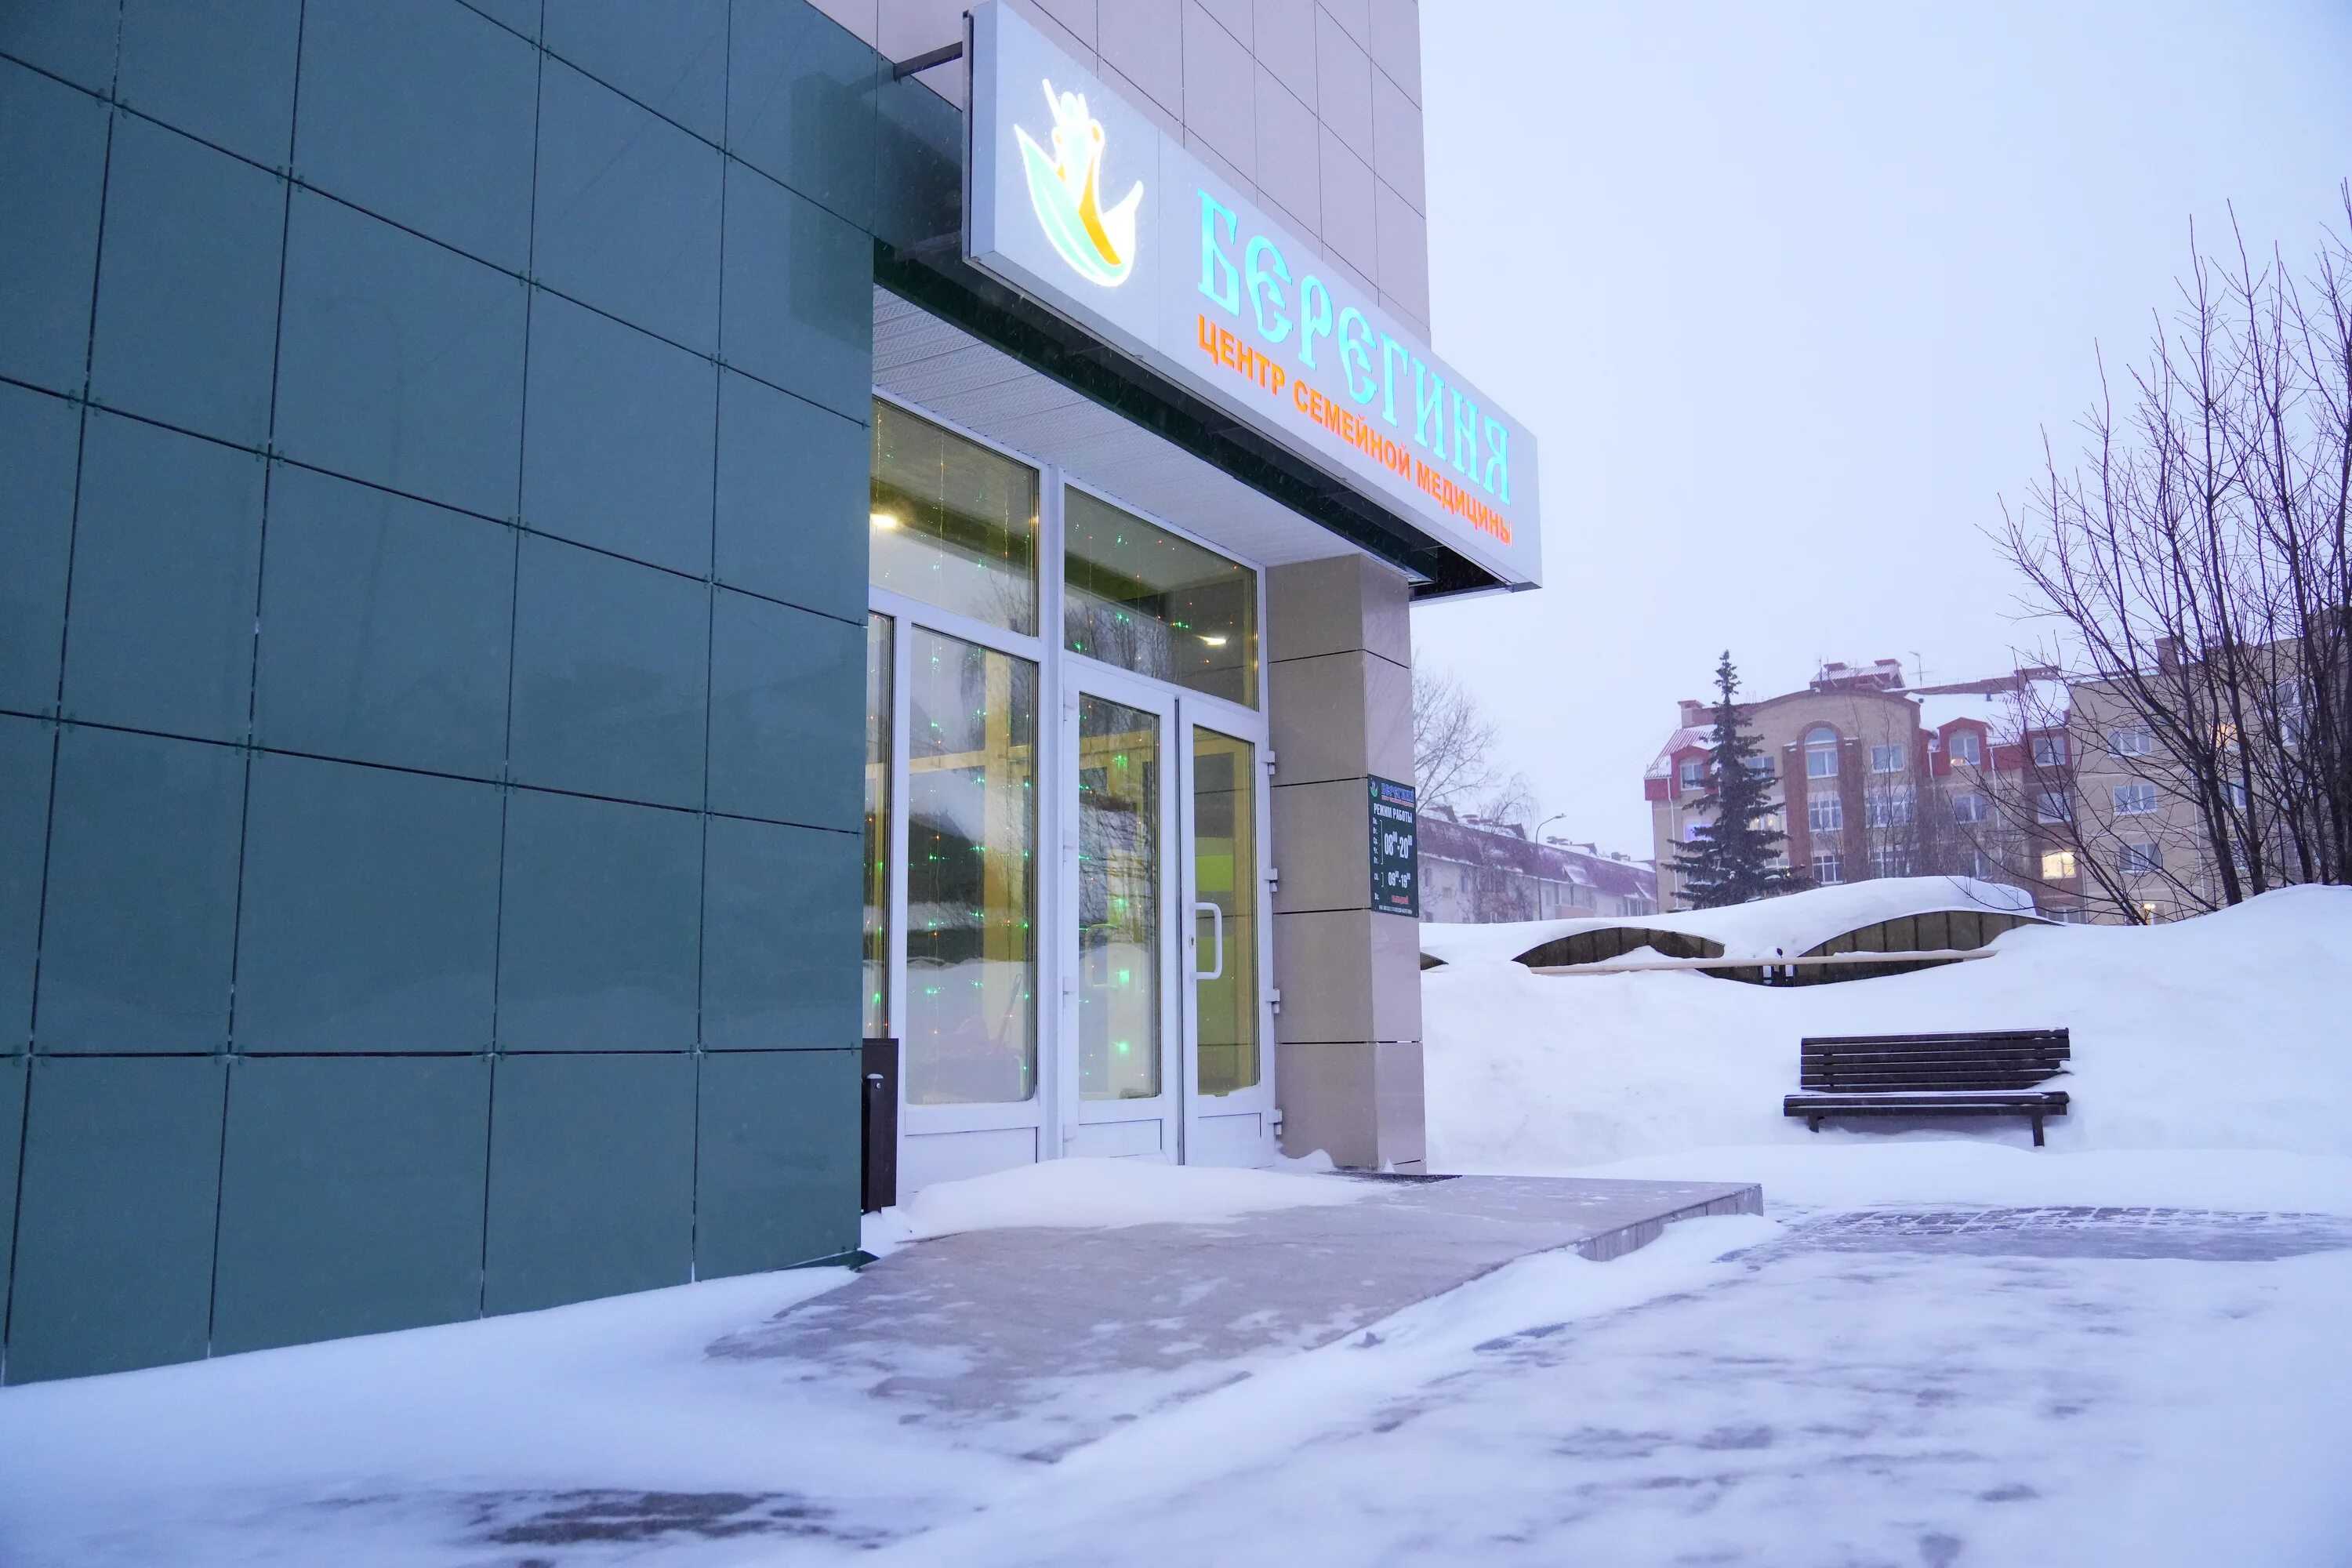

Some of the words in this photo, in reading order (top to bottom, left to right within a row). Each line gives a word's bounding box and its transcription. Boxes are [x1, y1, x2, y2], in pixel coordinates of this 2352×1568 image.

[1198, 314, 1285, 396] ЦЕНТР
[1294, 379, 1410, 481] СЕМЕЙНОЙ
[1417, 459, 1512, 548] МЕДИЦИНЫ
[1374, 803, 1392, 818] РЕЖИМ
[1392, 808, 1413, 823] РАБОТЫ
